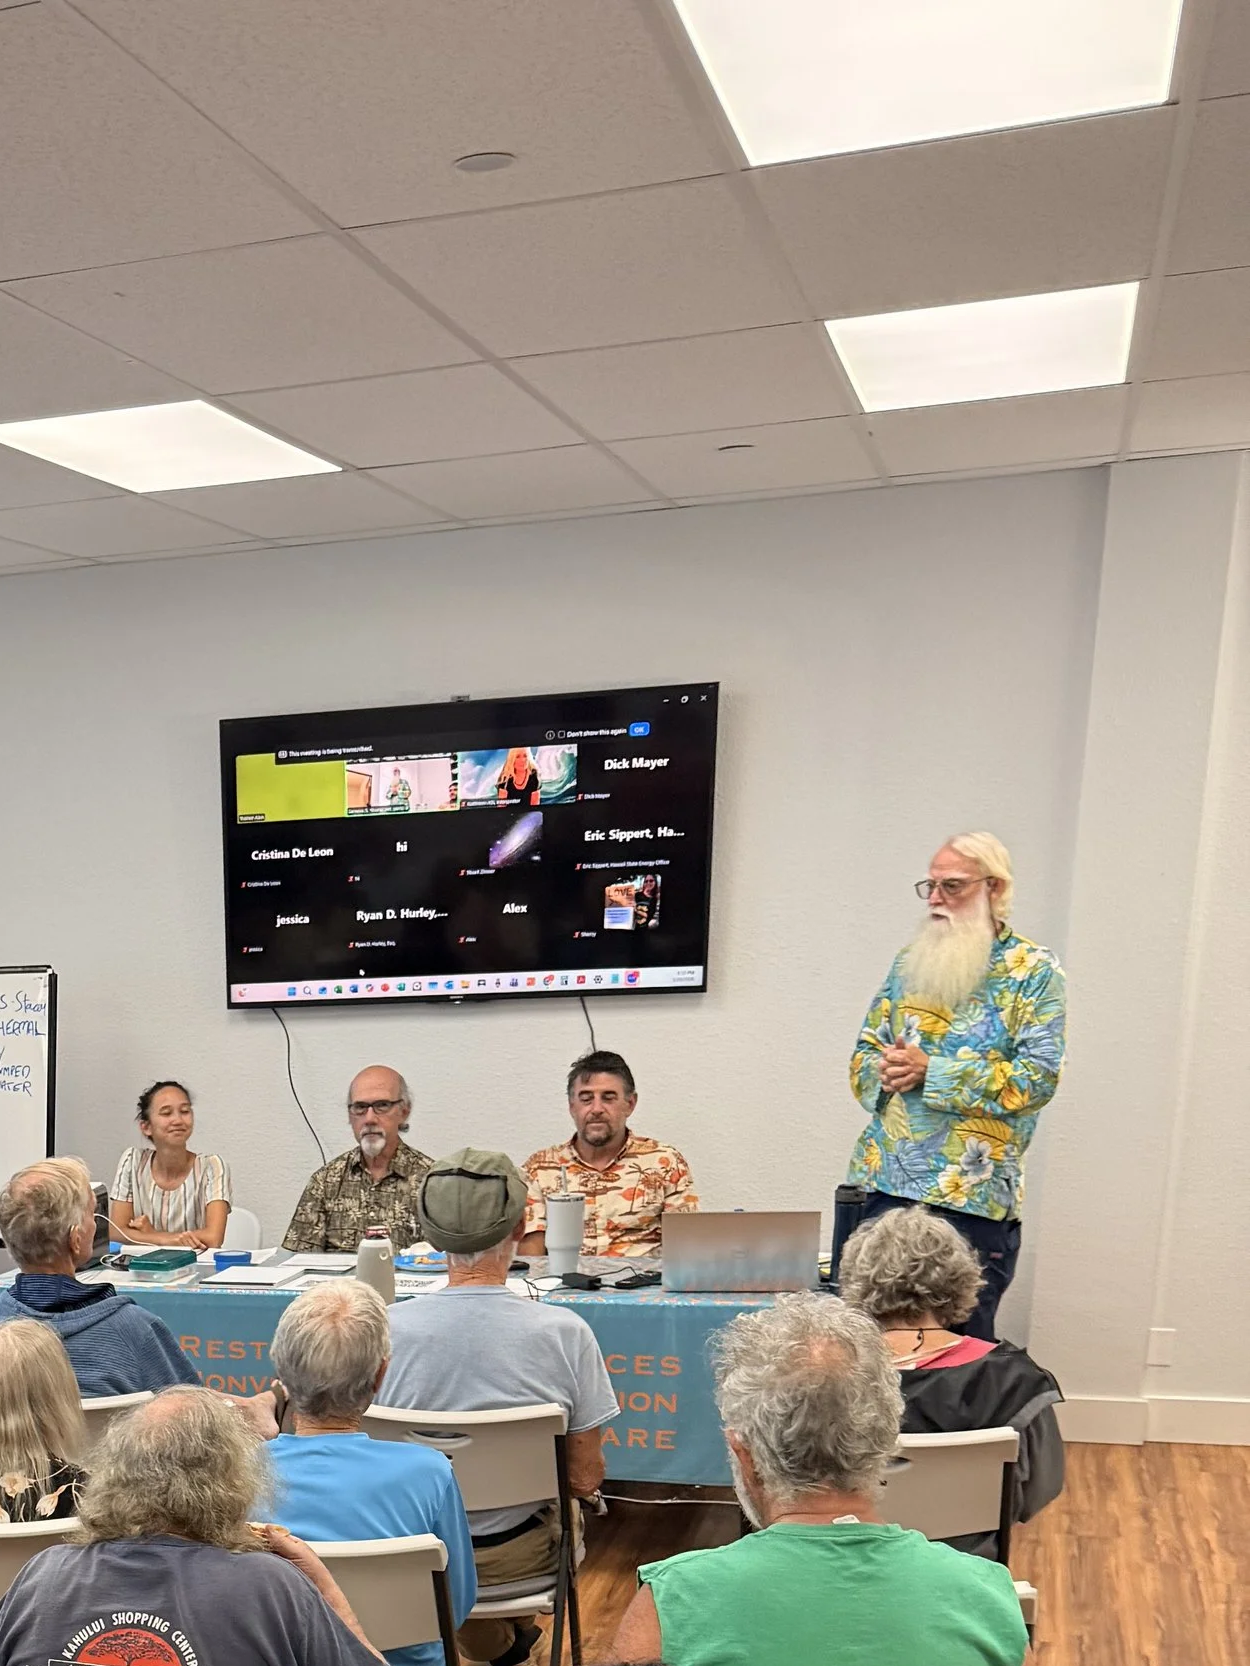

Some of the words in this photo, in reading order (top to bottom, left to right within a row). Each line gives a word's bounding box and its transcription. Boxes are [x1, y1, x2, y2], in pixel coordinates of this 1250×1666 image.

[604, 758, 630, 771] Dick
[631, 756, 669, 771] Mayer
[584, 830, 606, 842] Eric
[608, 828, 654, 843] Sippert,
[251, 849, 291, 861] Cristina
[291, 848, 307, 859] De
[308, 847, 334, 858] Leon
[396, 841, 408, 853] hi
[502, 902, 528, 914] Alex
[276, 914, 310, 928] jessica
[356, 910, 383, 924] Ryan
[386, 909, 397, 920] D.
[179, 1334, 271, 1361] REST
[61, 1618, 106, 1660] KAHULUI
[111, 1611, 171, 1633] SHOPPING
